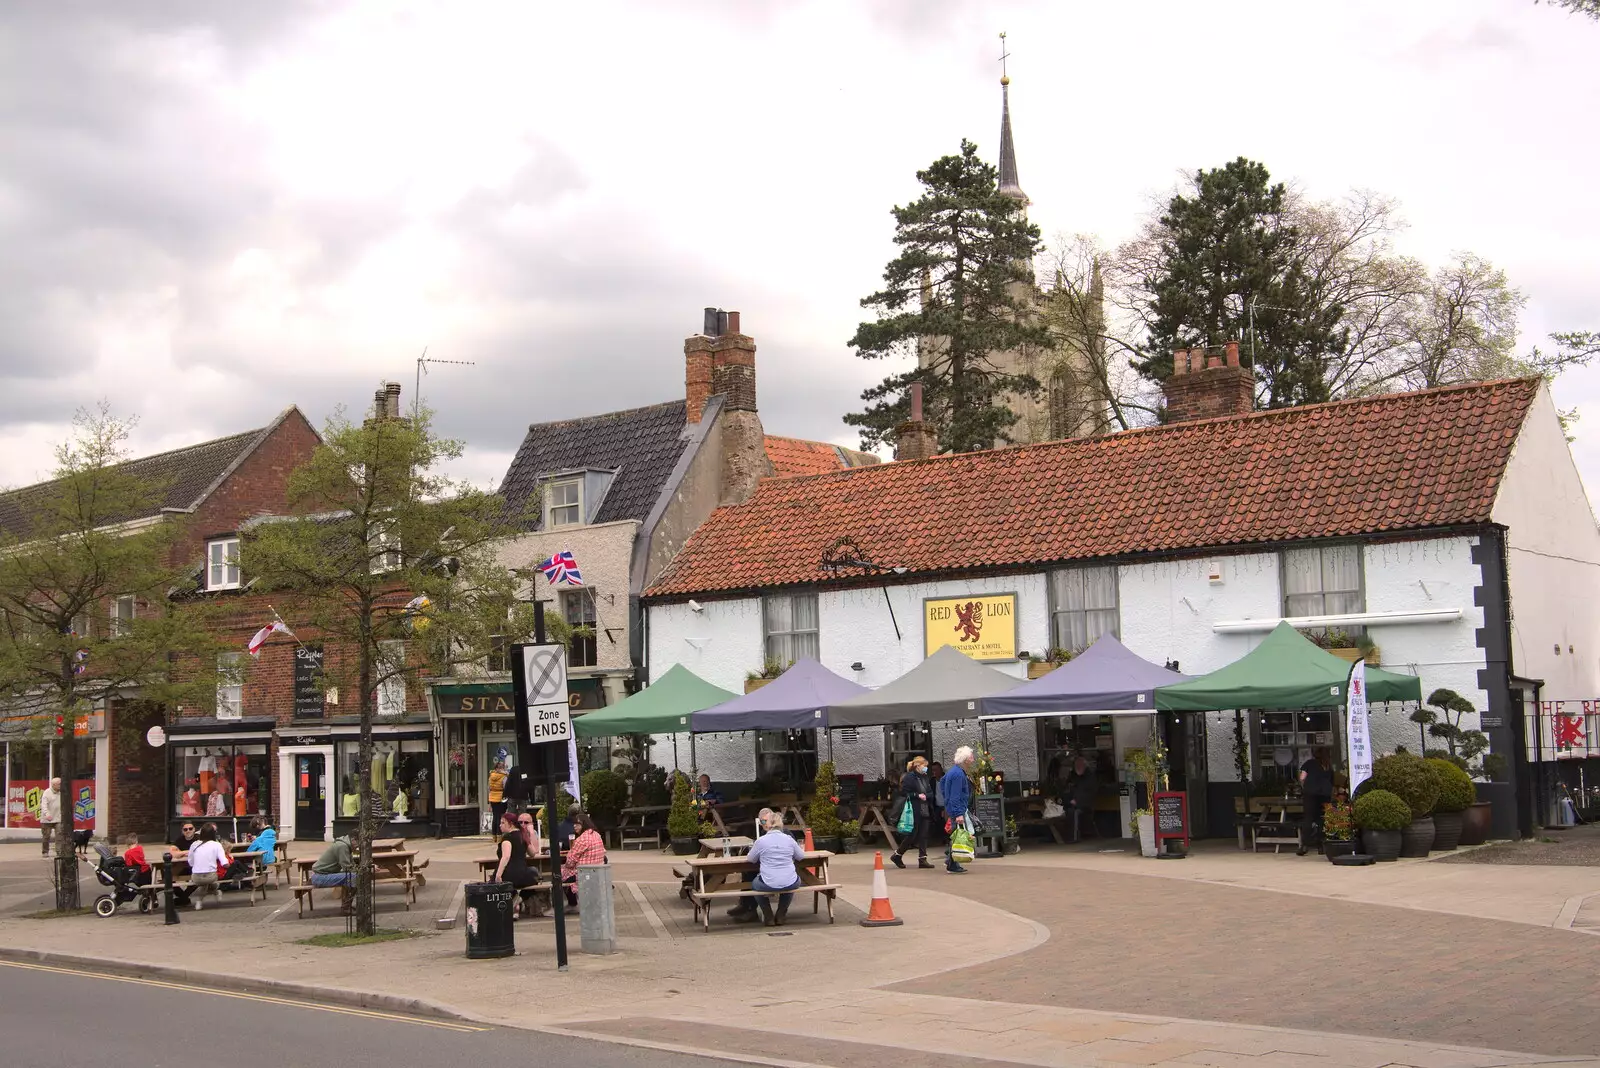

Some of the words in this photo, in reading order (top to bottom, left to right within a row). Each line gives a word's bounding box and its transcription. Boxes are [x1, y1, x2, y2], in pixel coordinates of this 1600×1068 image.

[930, 606, 951, 620] RED
[986, 602, 1011, 617] LION
[538, 710, 560, 720] Zone
[534, 722, 566, 737] ENDS
[28, 791, 38, 808] £1
[486, 892, 513, 901] LITTER
